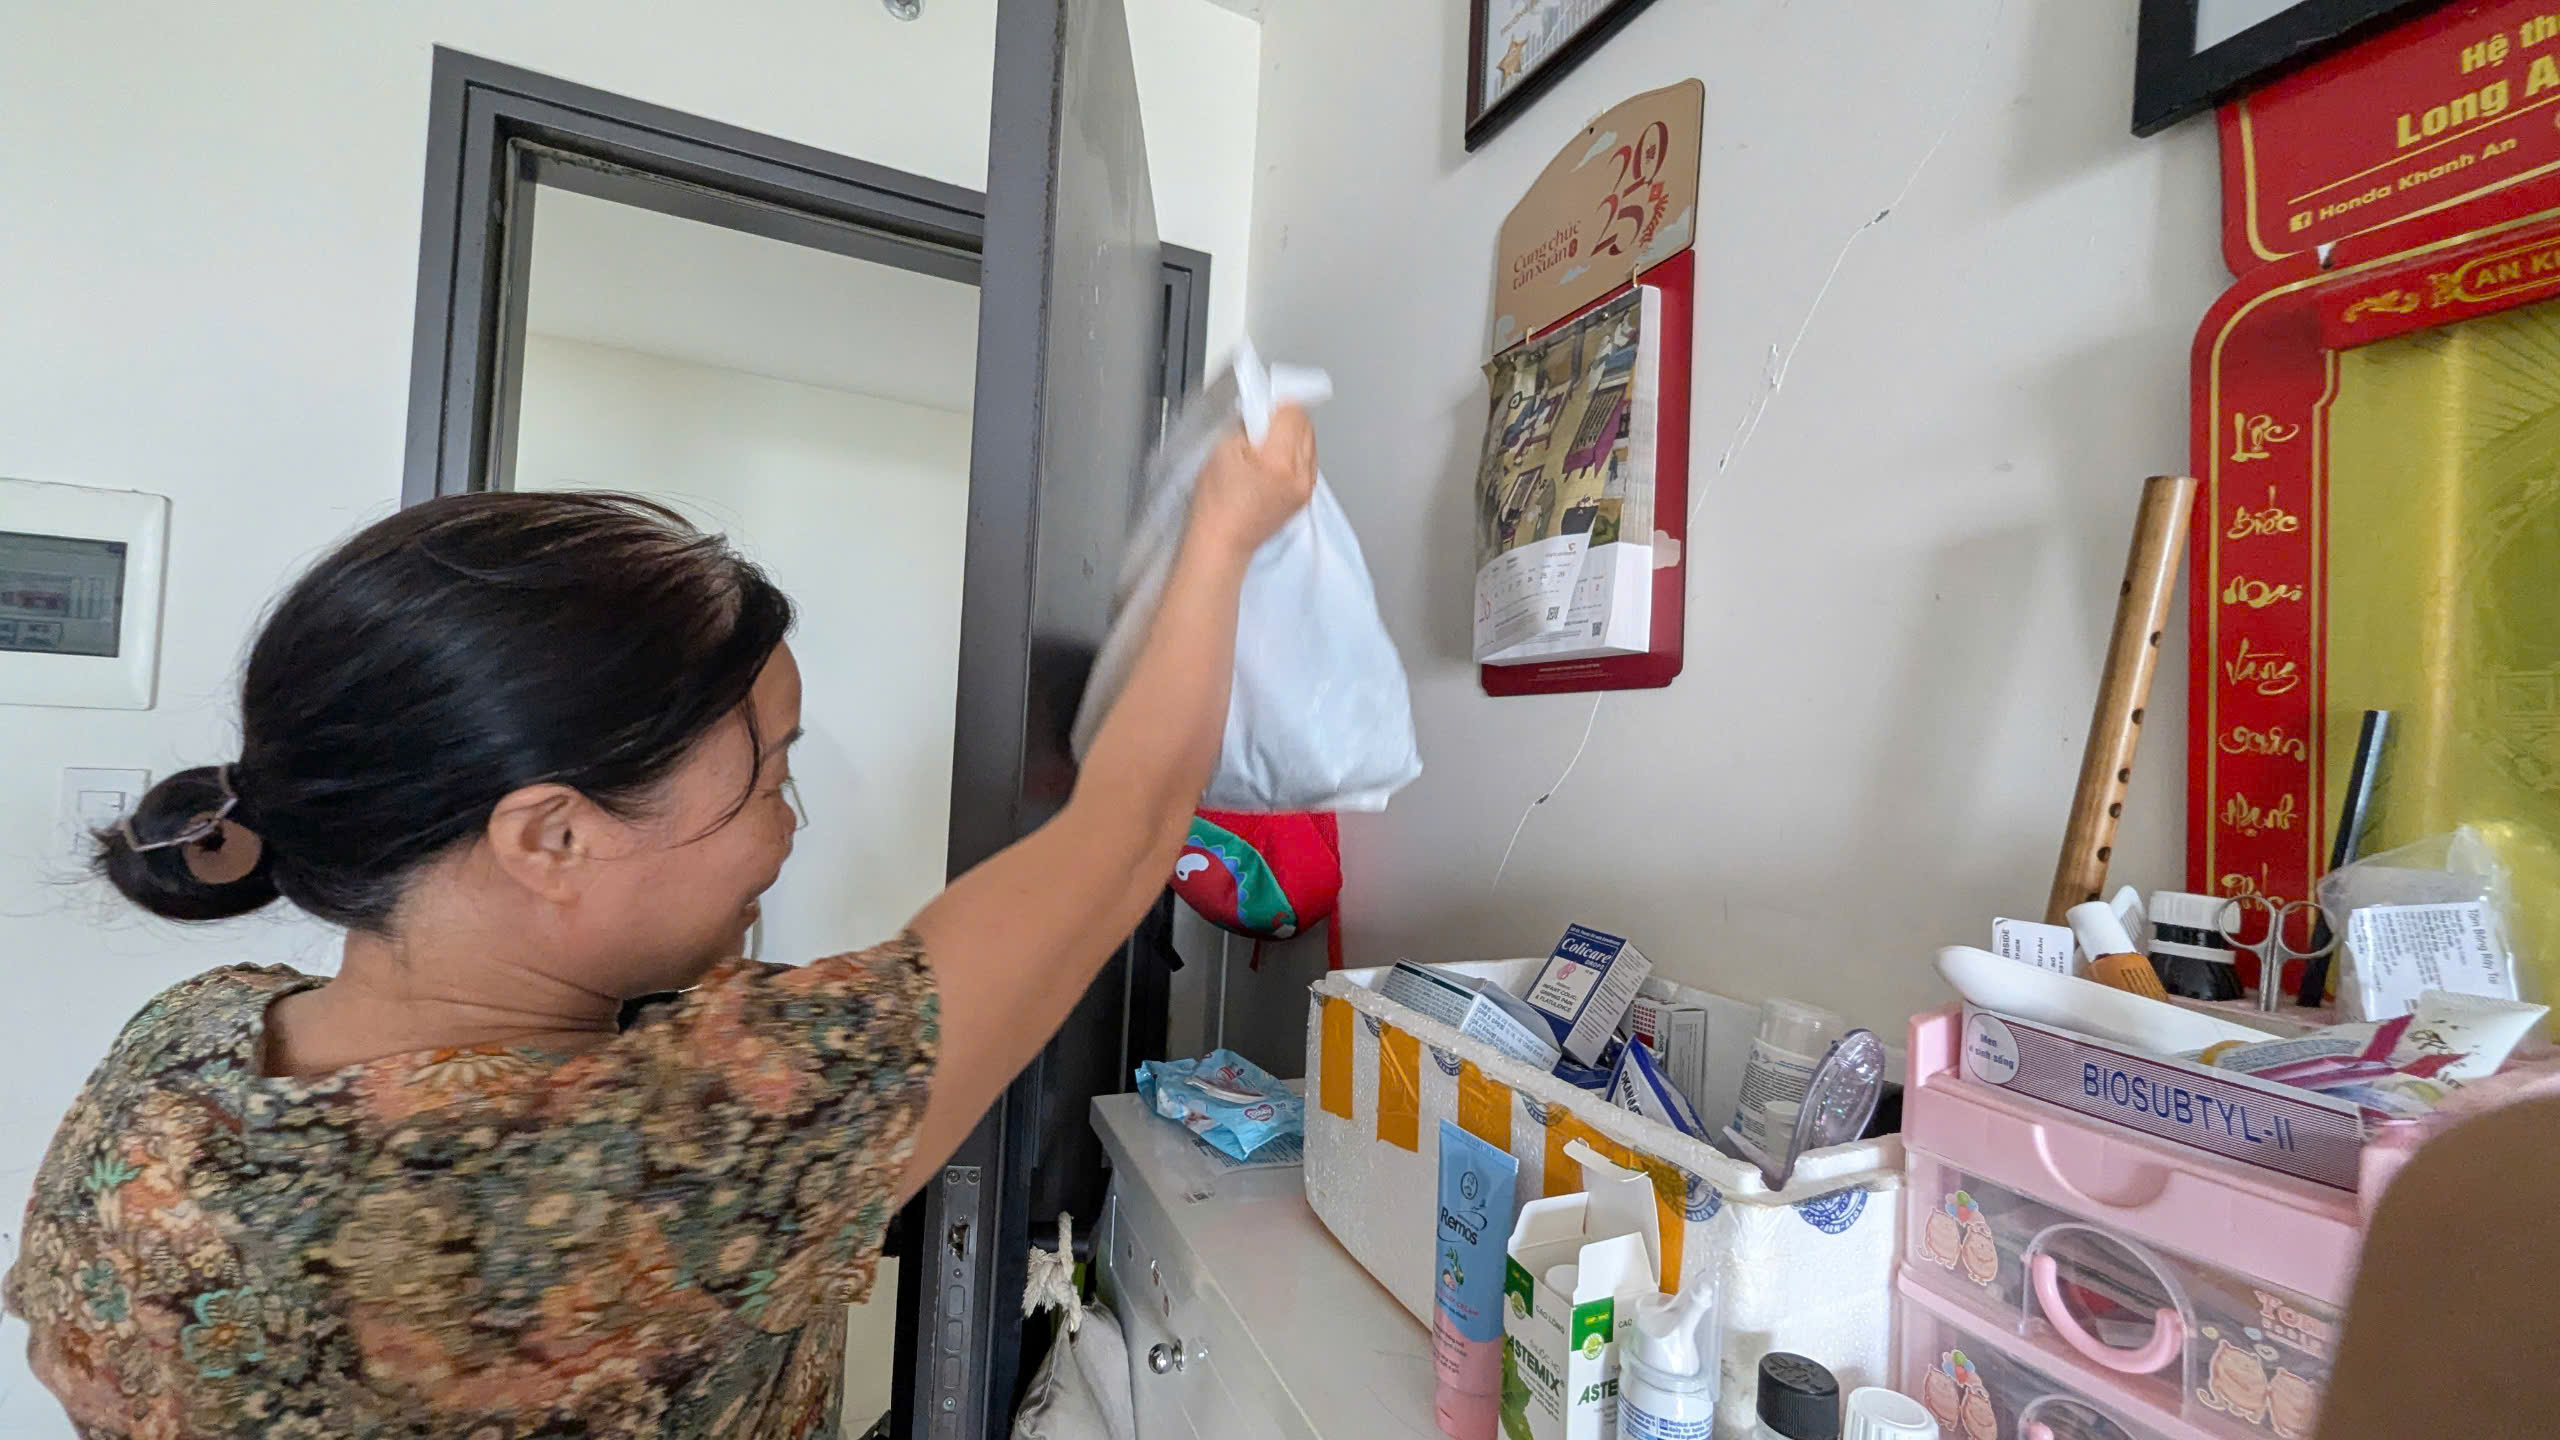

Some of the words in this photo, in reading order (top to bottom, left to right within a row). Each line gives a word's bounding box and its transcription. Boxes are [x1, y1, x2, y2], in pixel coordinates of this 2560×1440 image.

[2461, 33, 2509, 74] Hệ
[2397, 79, 2508, 148] Long
[2319, 185, 2392, 221] Honda
[2398, 154, 2476, 191] Khanh
[2481, 138, 2518, 160] An
[2475, 261, 2520, 288] AN
[1561, 937, 1612, 964] Colicare
[1975, 1047, 1991, 1060] sinh
[1993, 1054, 2014, 1071] sống
[2083, 1062, 2297, 1153] BIOSUBTYL-II
[1440, 1206, 1478, 1246] Remos
